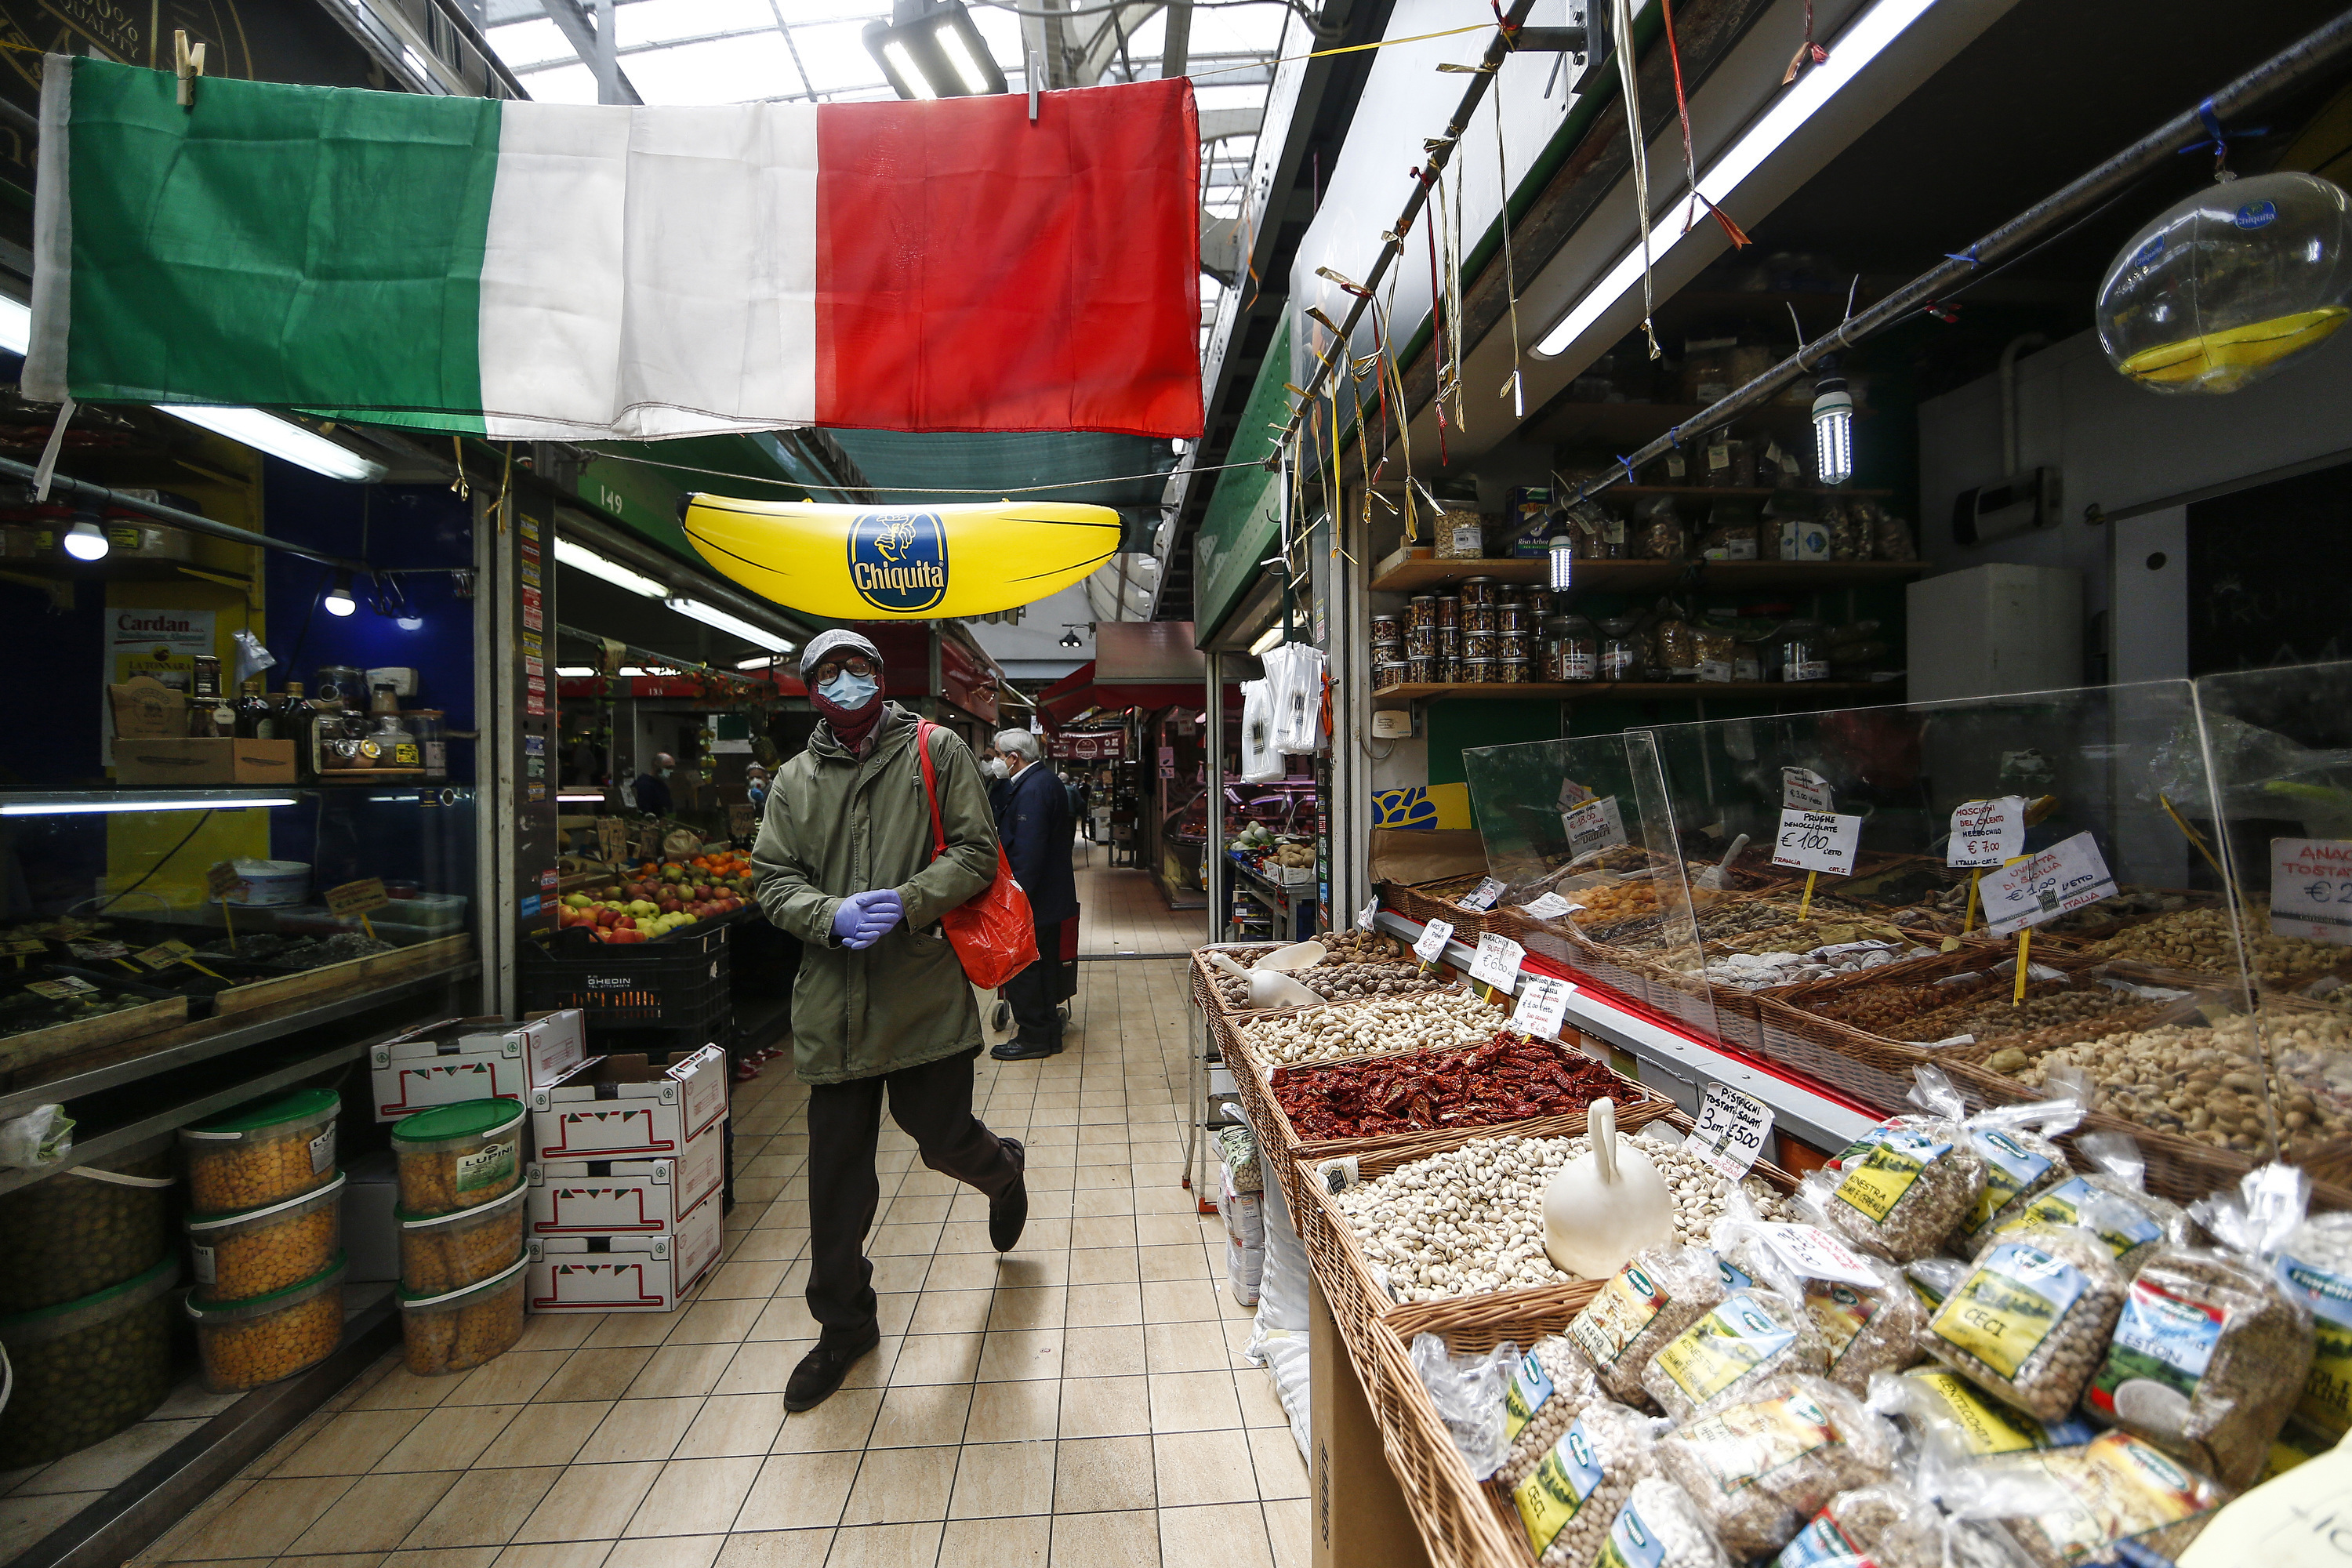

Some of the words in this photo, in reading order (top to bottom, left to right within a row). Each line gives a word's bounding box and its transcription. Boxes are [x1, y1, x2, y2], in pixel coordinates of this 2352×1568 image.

[2236, 212, 2275, 226] Chiquita
[601, 485, 622, 514] 149
[1518, 537, 1531, 546] Riso
[1532, 537, 1549, 546] Arbor
[854, 560, 945, 596] Chiquita
[118, 614, 191, 633] Cardan
[1803, 813, 1835, 823] PRUGNE
[1955, 804, 1995, 816] MOSCIONI
[1784, 821, 1838, 833] DENOCCIOLATE
[1976, 815, 2004, 825] CILENTO
[1780, 832, 1795, 847] €
[1797, 832, 1829, 850] 1,00
[1967, 840, 1978, 855] €
[1981, 840, 2000, 853] 7,00
[1773, 856, 1801, 866] FRANCIA
[2002, 883, 2016, 891] DI
[2005, 889, 2024, 901] €
[2027, 877, 2056, 895] 1,00
[2061, 874, 2094, 891] L'ETTO
[2303, 880, 2332, 903] €
[2063, 891, 2100, 910] ITALIA
[1483, 954, 1493, 967] €
[1530, 1021, 1537, 1030] €
[1720, 1087, 1761, 1116] PISTACCHI
[1700, 1107, 1715, 1130] 3
[465, 1145, 513, 1167] LUPINI
[1964, 1308, 2009, 1338] CECI
[1581, 1321, 1605, 1349] FARRO
[2124, 1333, 2183, 1364] ESTON
[1679, 1338, 1722, 1380] MINESTRA
[1527, 1485, 1546, 1520] CECI
